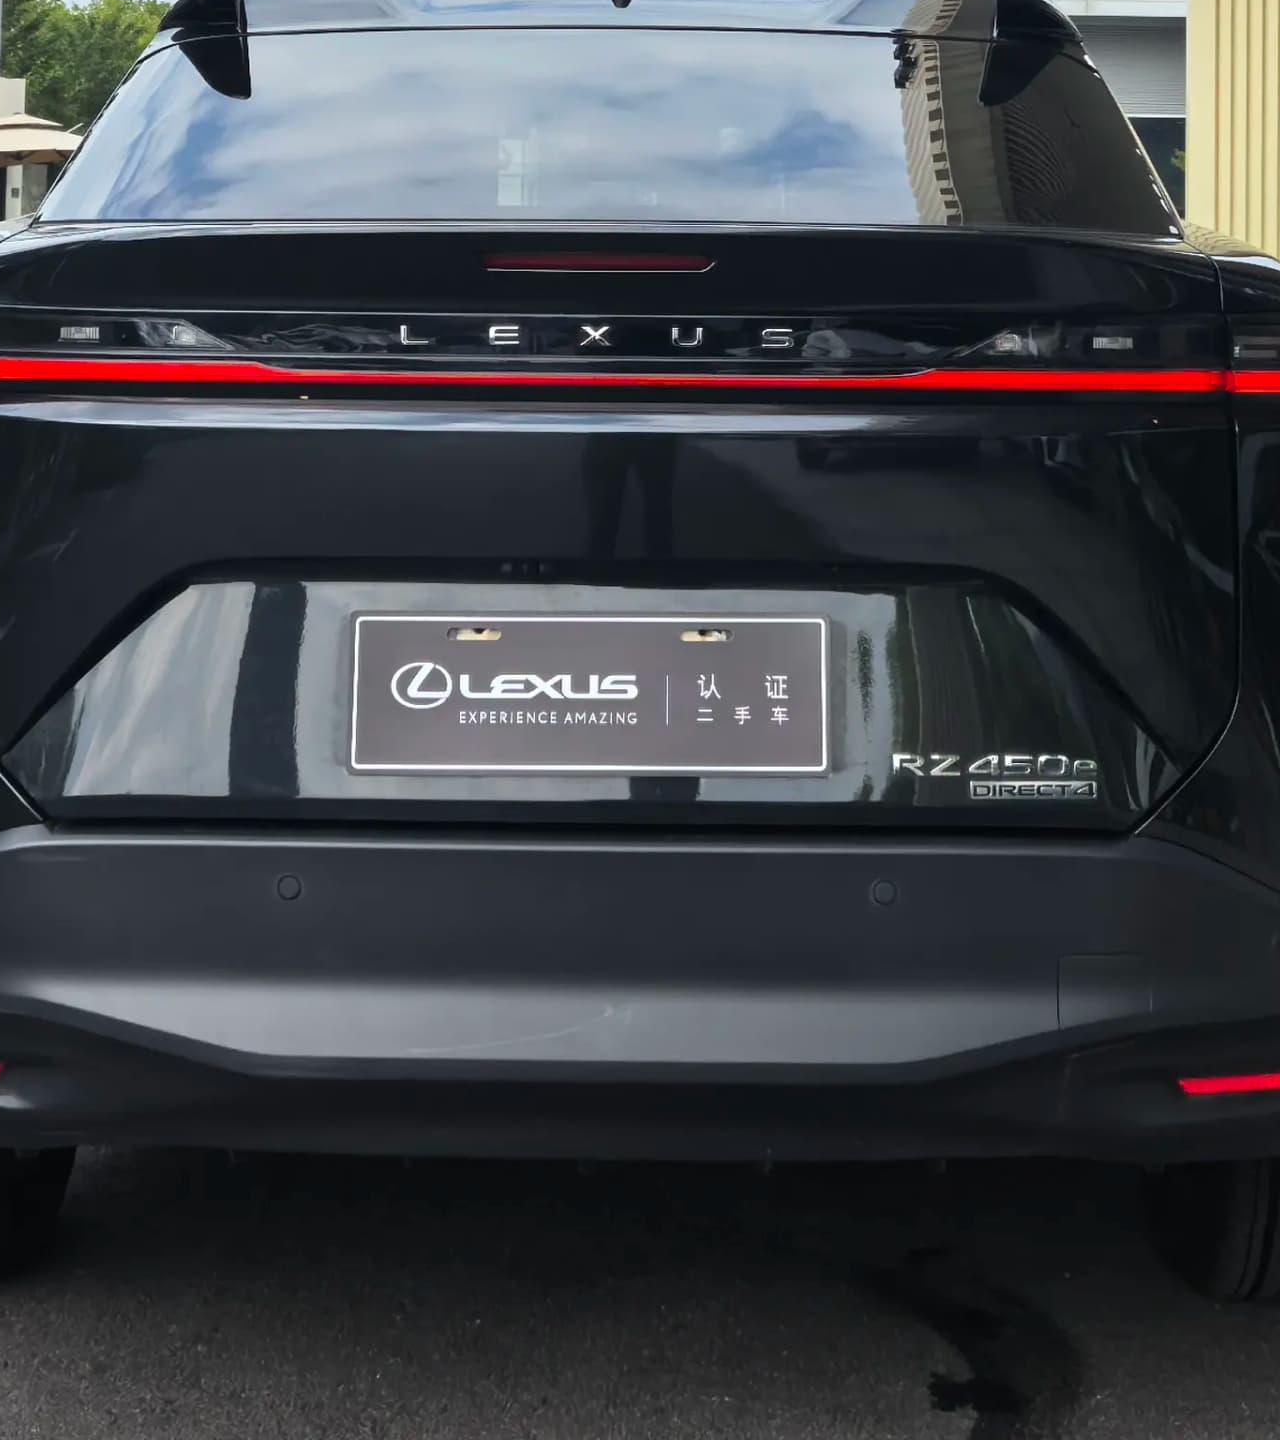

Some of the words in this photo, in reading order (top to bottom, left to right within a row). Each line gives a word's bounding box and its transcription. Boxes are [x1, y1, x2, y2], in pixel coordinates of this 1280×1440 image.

[399, 324, 796, 349] LEXUS
[459, 674, 639, 700] LEXUS
[697, 673, 789, 699] 认证
[459, 711, 557, 725] EXPERIENCE
[564, 711, 639, 725] AMAZING
[696, 705, 790, 726] 二手车
[892, 753, 961, 777] RZ
[968, 754, 1098, 777] 450e
[972, 782, 1096, 799] DIRECT4
